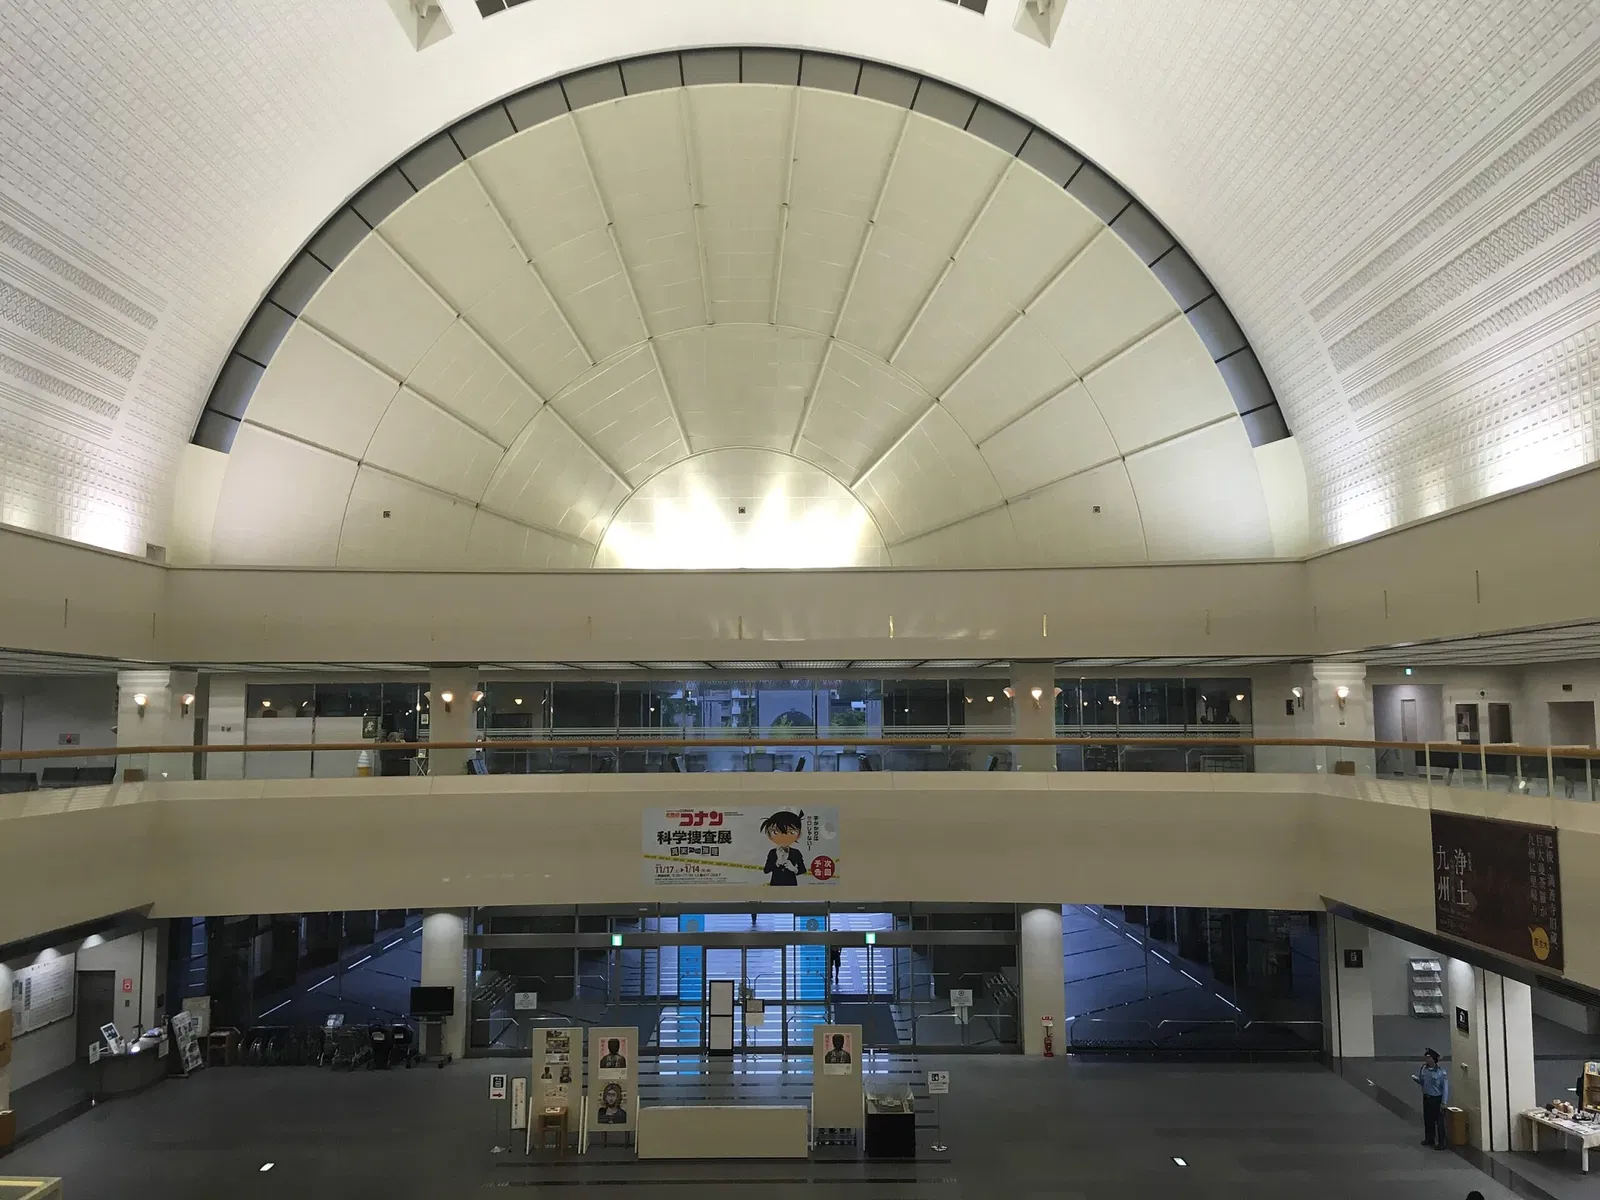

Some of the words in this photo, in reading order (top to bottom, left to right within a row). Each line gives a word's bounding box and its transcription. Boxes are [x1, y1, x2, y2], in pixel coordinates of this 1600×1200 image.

[679, 811, 723, 826] コナン
[657, 830, 732, 845] 科学捜査展
[684, 865, 700, 873] 1/14
[814, 860, 822, 876] 予告
[824, 860, 832, 876] 次回
[1436, 845, 1450, 901] 九州
[1454, 848, 1469, 906] 浄土
